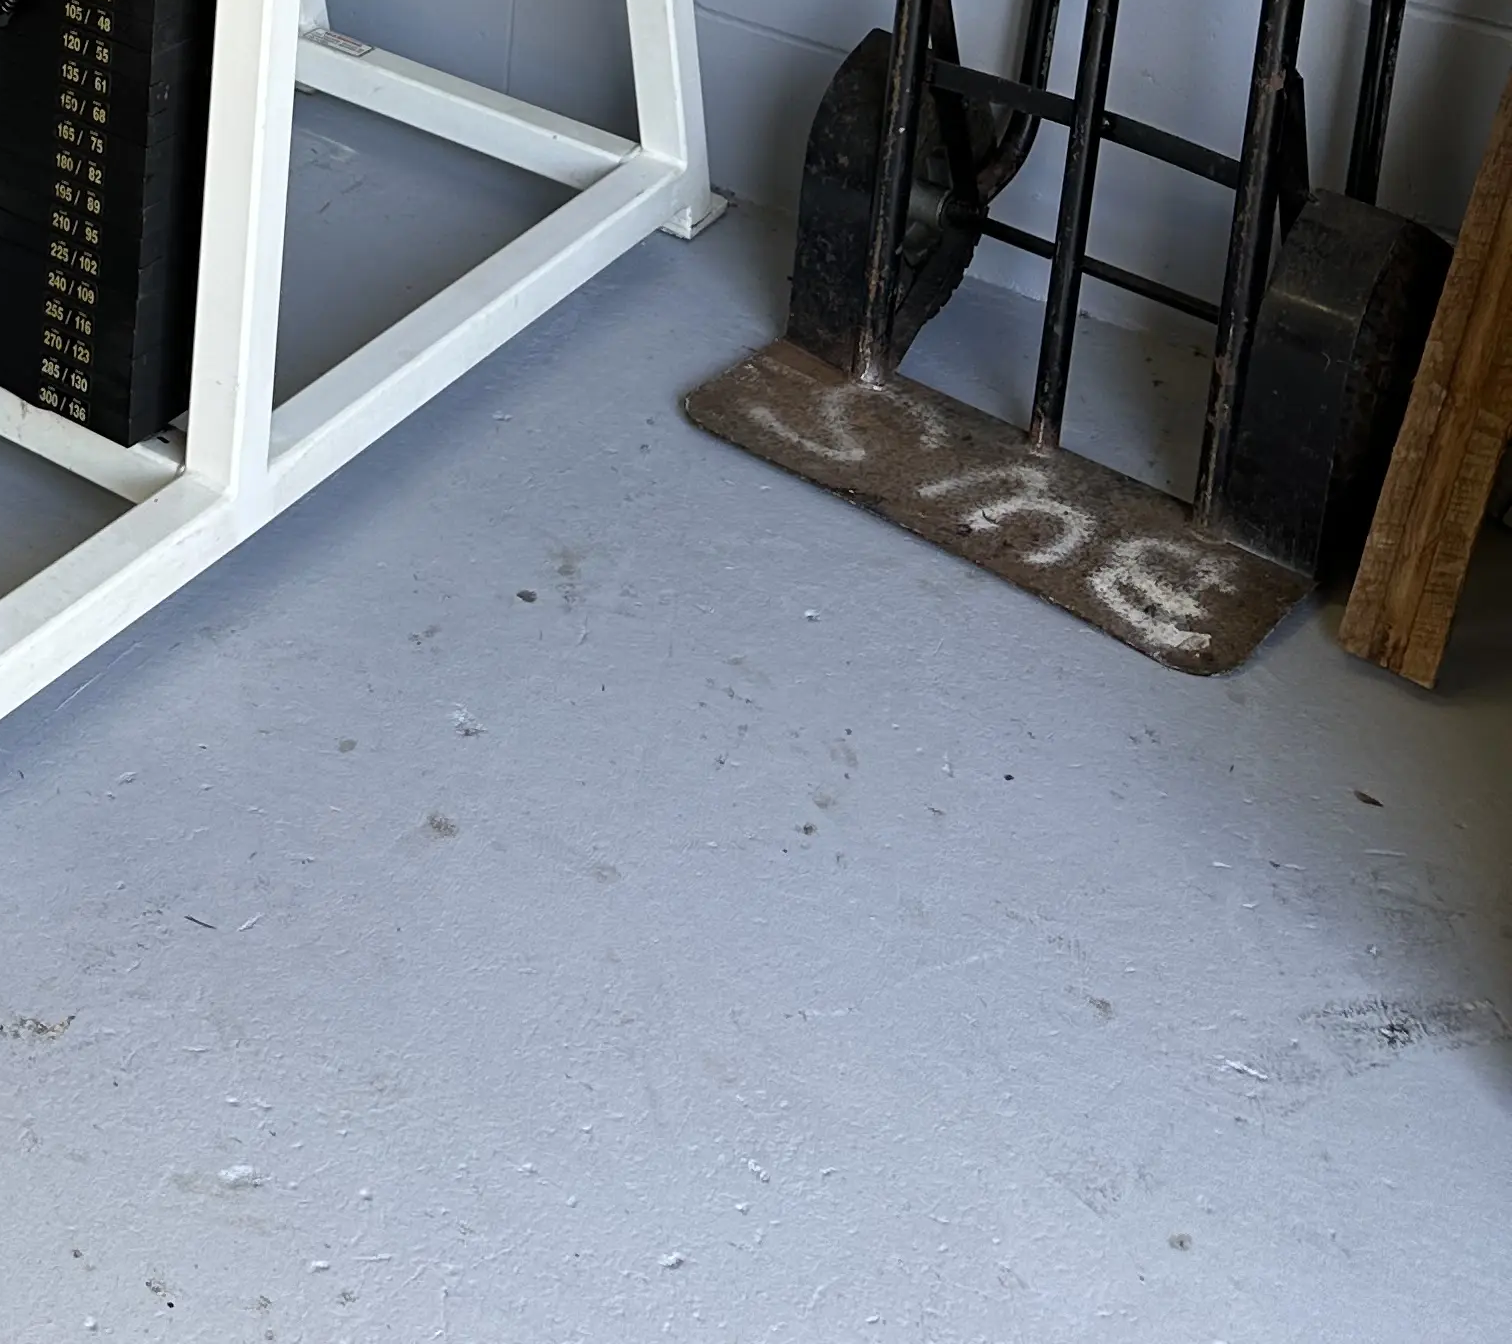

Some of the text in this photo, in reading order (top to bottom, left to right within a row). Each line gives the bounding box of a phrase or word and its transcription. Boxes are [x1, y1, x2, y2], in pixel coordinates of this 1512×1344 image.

[65, 2, 83, 21] 105
[97, 15, 111, 32] 48
[63, 33, 81, 52] 120
[95, 46, 109, 63] 55
[62, 63, 79, 82] 135
[94, 76, 107, 93] 61
[60, 93, 78, 112] 150
[92, 106, 106, 124] 68
[57, 122, 75, 142] 165
[90, 136, 103, 154] 75
[56, 153, 74, 172] 180
[88, 166, 102, 185] 82
[55, 182, 72, 202] 195
[87, 196, 101, 214] 89
[52, 212, 70, 232] 210
[85, 226, 98, 244] 95
[50, 242, 69, 262] 225
[79, 255, 98, 276] 102
[48, 272, 67, 292] 240
[77, 285, 95, 305] 109
[45, 300, 64, 321] 255
[75, 315, 92, 335] 116
[43, 330, 62, 350] 270
[72, 344, 90, 364] 123
[41, 358, 60, 379] 285
[70, 372, 88, 393] 130
[39, 387, 58, 407] 300
[68, 401, 86, 422] 136
